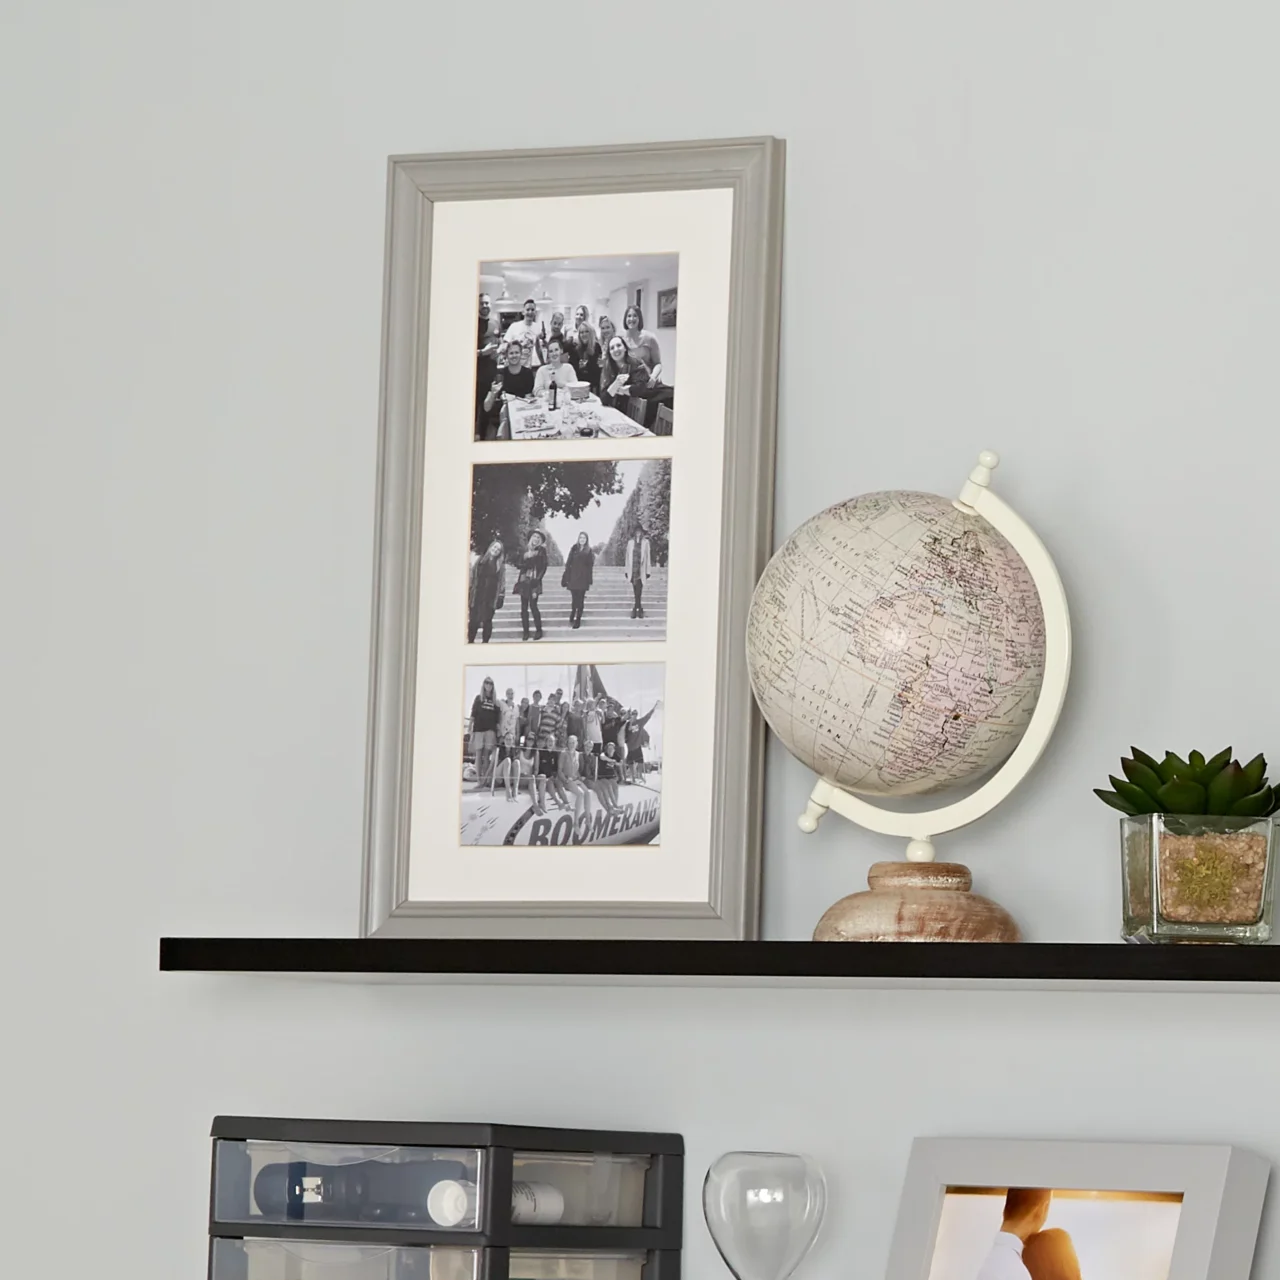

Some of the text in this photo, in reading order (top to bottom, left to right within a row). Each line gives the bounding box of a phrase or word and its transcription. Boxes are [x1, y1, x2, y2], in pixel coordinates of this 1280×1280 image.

[814, 545, 858, 581] ATLANTIC
[801, 695, 863, 734] ATLANTIC
[811, 684, 850, 709] SOUTH
[800, 713, 842, 739] OCEAN
[528, 796, 660, 846] BOOMERANG
